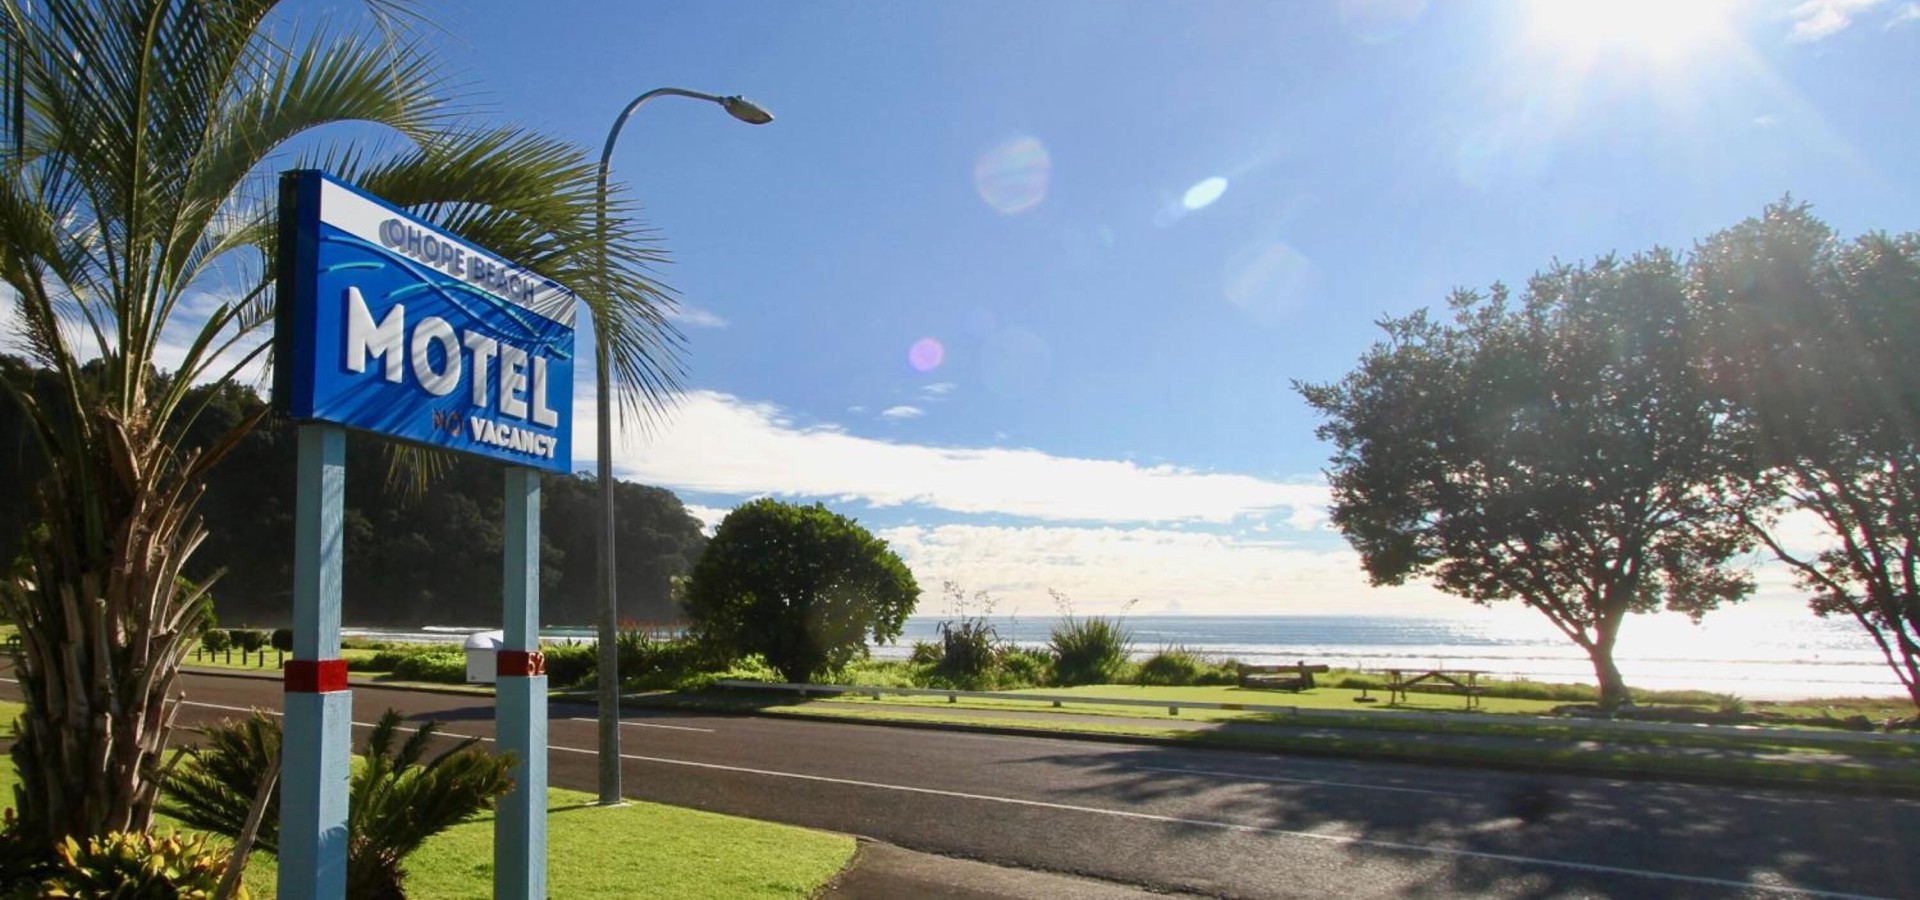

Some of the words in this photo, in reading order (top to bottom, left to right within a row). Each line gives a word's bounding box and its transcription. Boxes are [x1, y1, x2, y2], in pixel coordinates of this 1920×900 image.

[384, 218, 465, 275] OHOPE
[471, 255, 535, 303] BEACH
[347, 286, 558, 428] MOTEL
[432, 408, 464, 437] NO
[470, 416, 557, 458] VACANCY
[528, 651, 545, 675] 52
